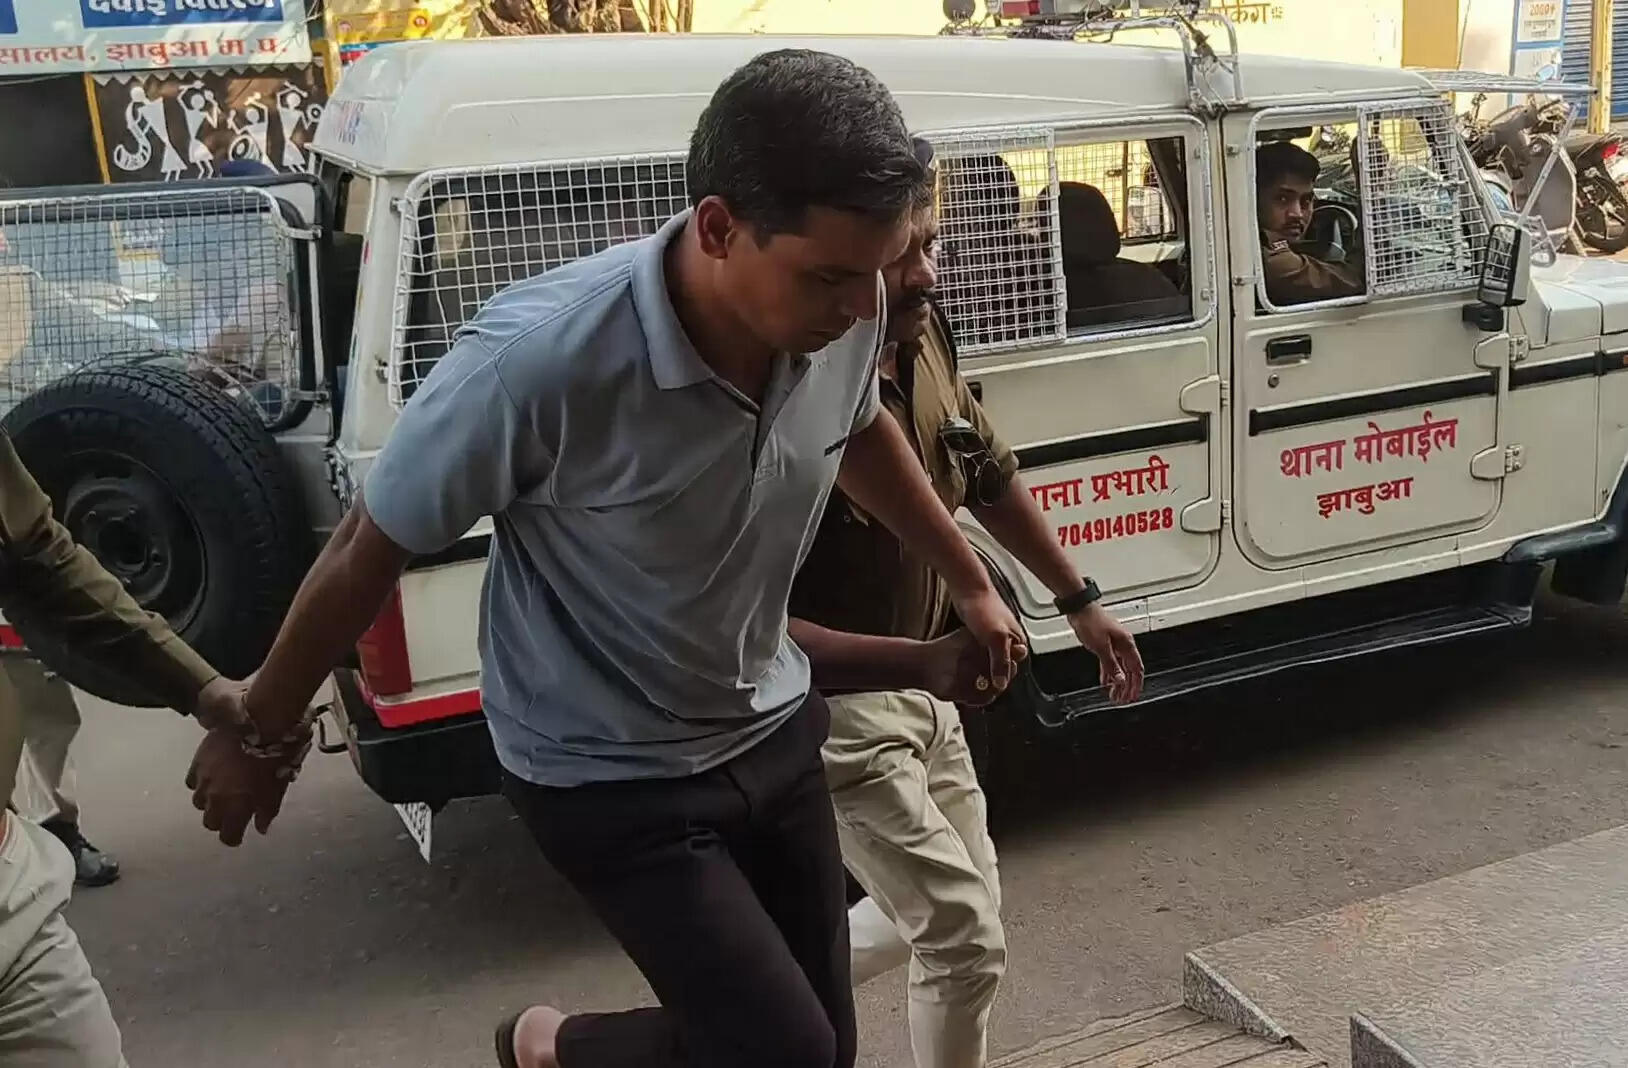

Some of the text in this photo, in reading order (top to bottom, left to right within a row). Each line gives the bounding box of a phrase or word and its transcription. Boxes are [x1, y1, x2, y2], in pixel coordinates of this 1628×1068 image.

[105, 40, 209, 66] झाबुआ
[1280, 410, 1459, 478] थाना मोबाईल
[1091, 454, 1170, 503] प्रभारी
[1317, 476, 1414, 519] झाबुआ
[1057, 506, 1174, 547] 7049140528
